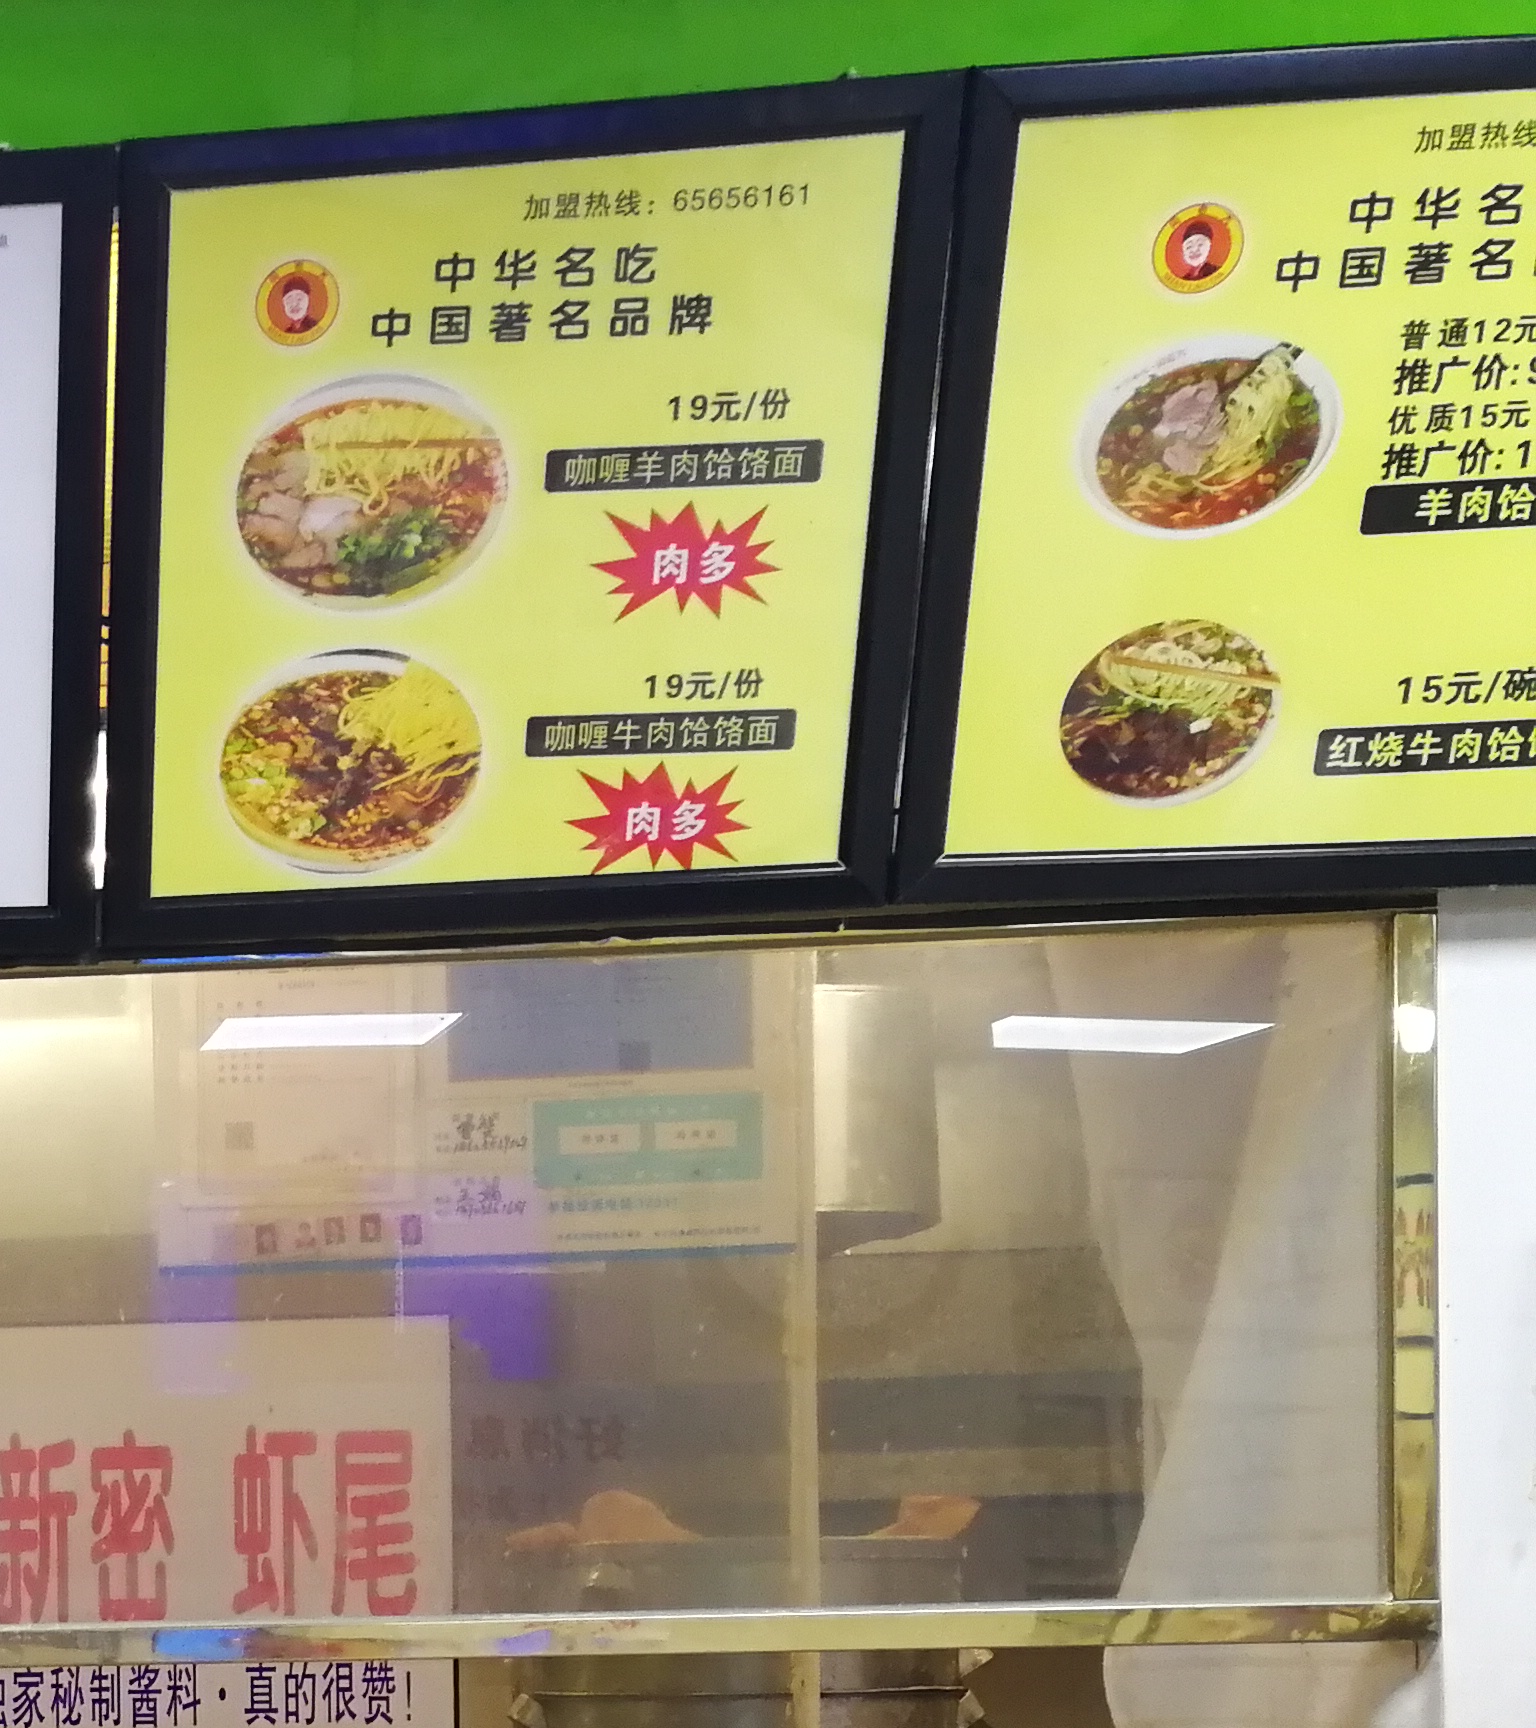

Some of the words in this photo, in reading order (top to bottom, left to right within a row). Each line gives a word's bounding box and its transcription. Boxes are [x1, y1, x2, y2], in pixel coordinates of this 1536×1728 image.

[1414, 120, 1536, 153] 加盟热线
[523, 184, 808, 221] 加盟热线：65656161
[1349, 184, 1523, 234] 中华名
[435, 243, 657, 293] 中华名吃
[1276, 239, 1536, 292] 中国著名
[371, 293, 712, 347] 中国著名品牌
[1401, 315, 1536, 354] 普通12元
[668, 388, 790, 422] 19元/份
[1388, 400, 1530, 439] 优质15元
[563, 443, 805, 489] 咖喱羊肉饸饹面
[651, 542, 736, 586] 肉多
[645, 669, 763, 700] 19元/份
[542, 712, 779, 754] 咖喱牛肉饸饹面
[1326, 728, 1536, 771] 红烧牛肉饸
[624, 802, 708, 841] 肉多
[233, 1425, 418, 1618] 虾尾
